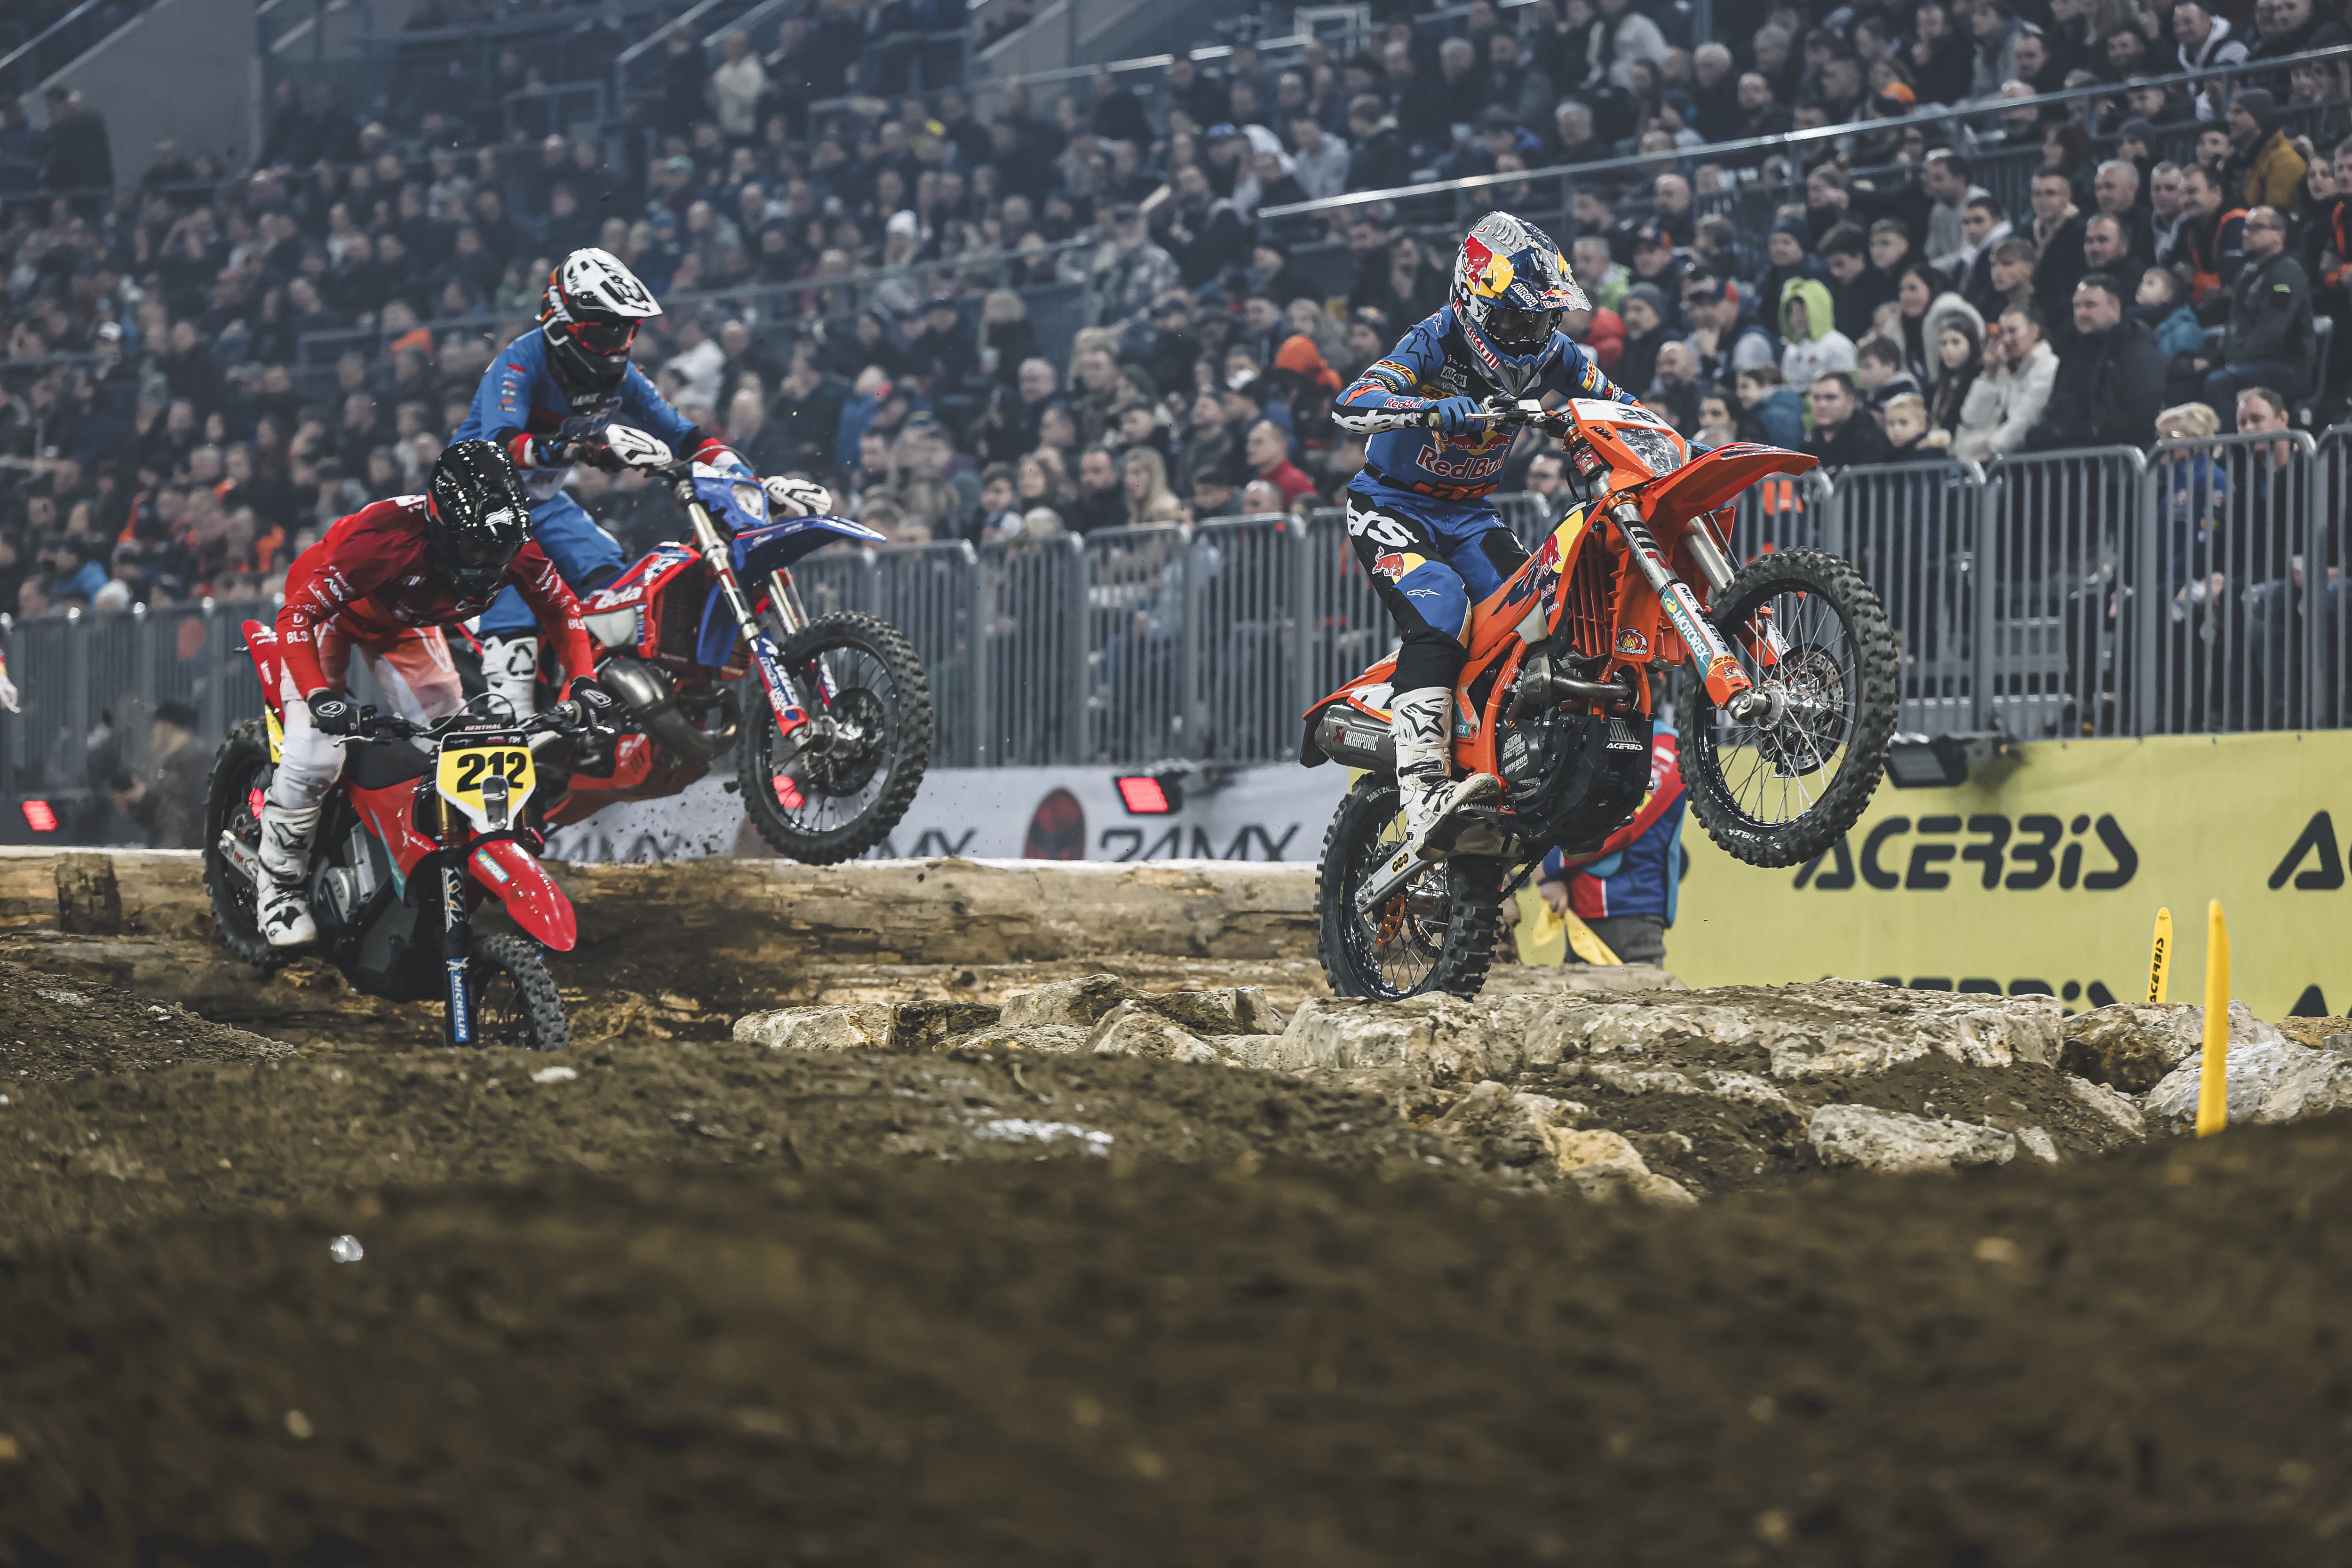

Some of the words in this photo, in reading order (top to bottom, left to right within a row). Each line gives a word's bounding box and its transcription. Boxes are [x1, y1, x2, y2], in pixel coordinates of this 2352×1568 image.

[1510, 283, 1539, 307] AIROH
[1471, 334, 1500, 370] Bull
[1376, 367, 1407, 386] MOTOREX
[1384, 398, 1405, 409] Red
[1403, 399, 1426, 409] Bull
[1415, 444, 1474, 479] Red
[1468, 445, 1510, 479] Bull
[589, 587, 643, 610] Beta
[1545, 601, 1560, 616] AIROH
[286, 631, 310, 644] BLS
[1672, 609, 1710, 661] MOTOREX
[1503, 740, 1525, 761] FACTORY
[1504, 734, 1522, 753] KTM
[457, 751, 526, 793] 212
[1505, 753, 1528, 773] HINSON
[1794, 814, 2139, 890] ACERBIS
[2149, 937, 2164, 1002] ACERBIS
[454, 975, 467, 1039] MICHELIN
